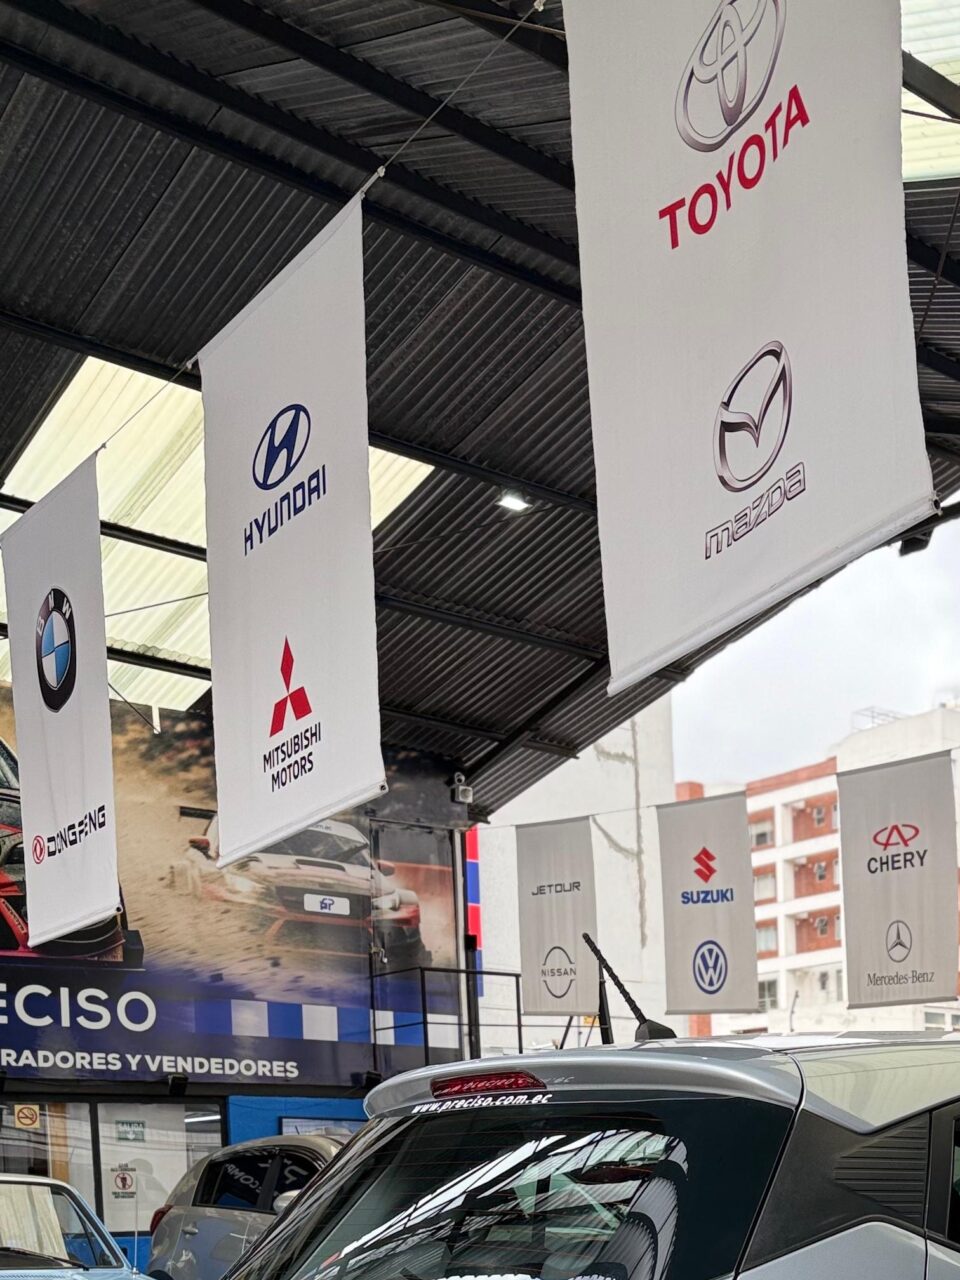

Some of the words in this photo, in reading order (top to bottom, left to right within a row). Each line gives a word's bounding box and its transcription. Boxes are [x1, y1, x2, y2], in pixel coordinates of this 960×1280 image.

[658, 84, 810, 250] TOYOTA
[244, 463, 327, 557] HYUNDAI
[705, 461, 806, 560] mazda
[263, 721, 321, 773] MITSUBISHI
[271, 751, 314, 793] MOTORS
[47, 804, 106, 858] DONGFENG
[867, 849, 928, 874] CHERY
[531, 881, 581, 896] JETOUR
[681, 888, 734, 904] SUZUKI
[541, 967, 577, 977] NISSAN
[867, 969, 935, 987] Mercedes-Benz
[125, 1054, 140, 1071] Y
[144, 1054, 300, 1078] VENDEDORES
[411, 1093, 553, 1114] www.preciso.com.ec
[118, 1121, 145, 1132] SALIDA
